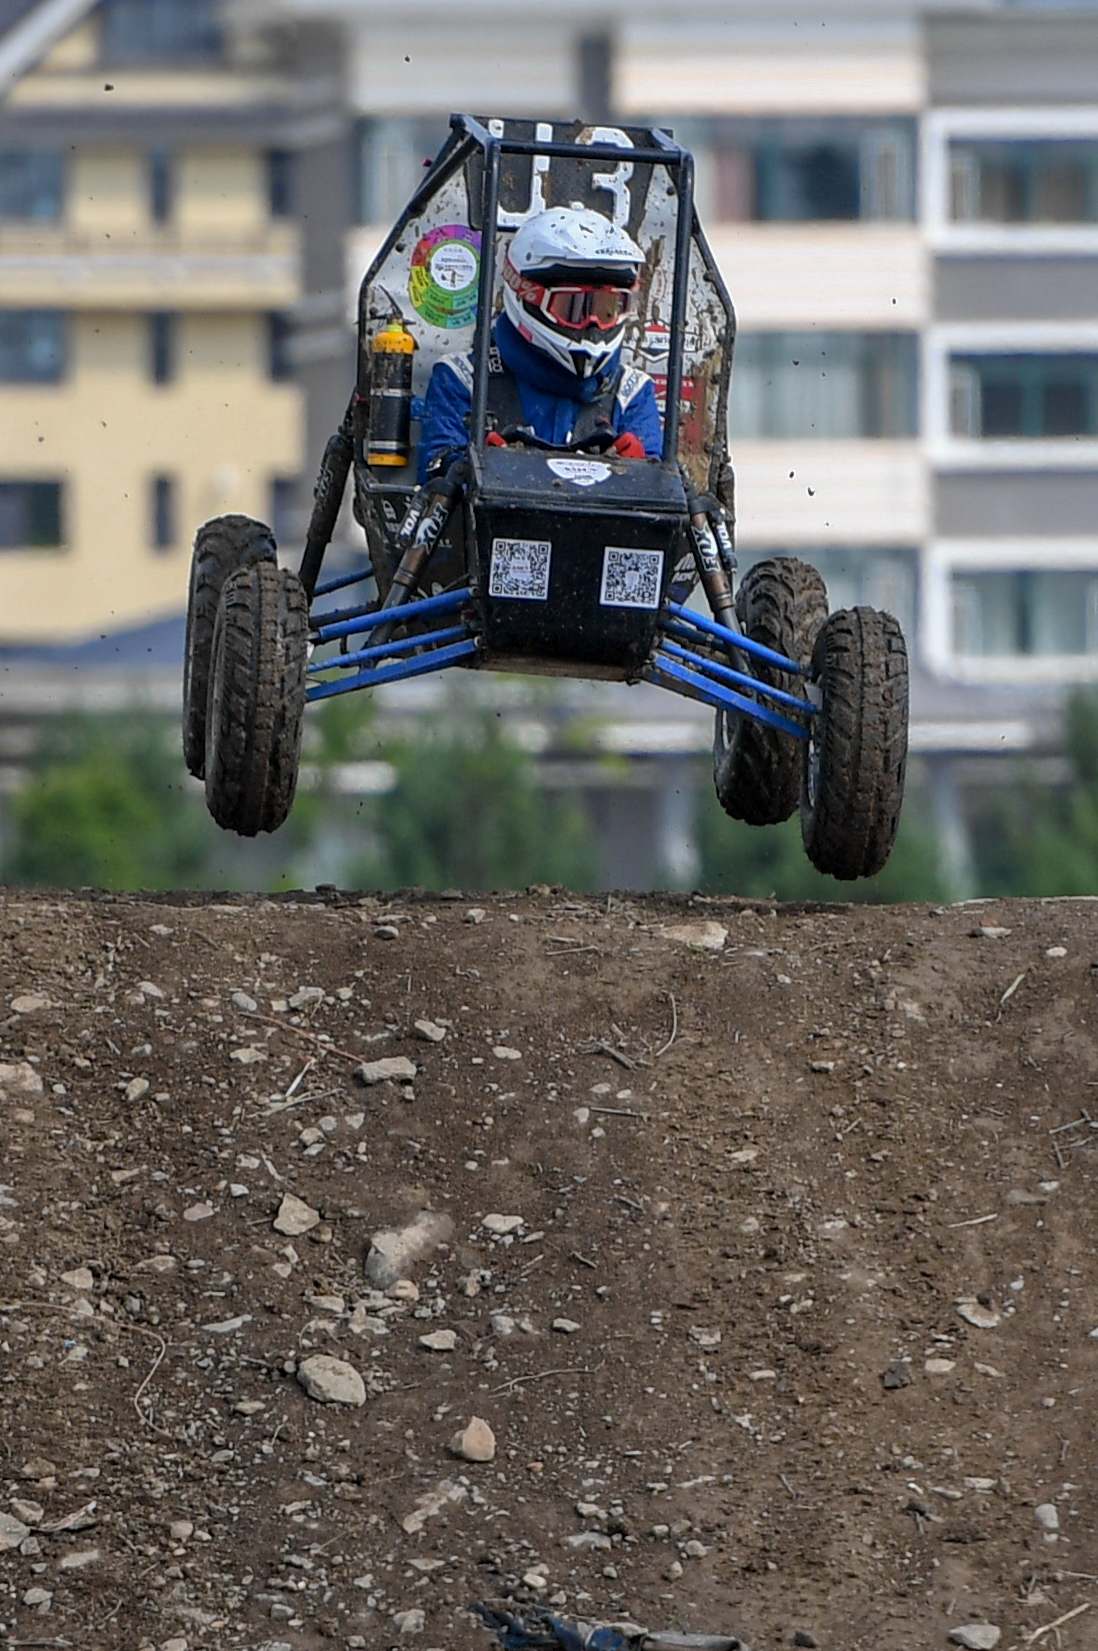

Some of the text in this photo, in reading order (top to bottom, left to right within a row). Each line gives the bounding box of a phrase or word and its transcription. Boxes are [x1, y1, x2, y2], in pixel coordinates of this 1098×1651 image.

[487, 119, 635, 229] U3
[411, 501, 449, 556] FOX
[690, 519, 721, 573] FOX
